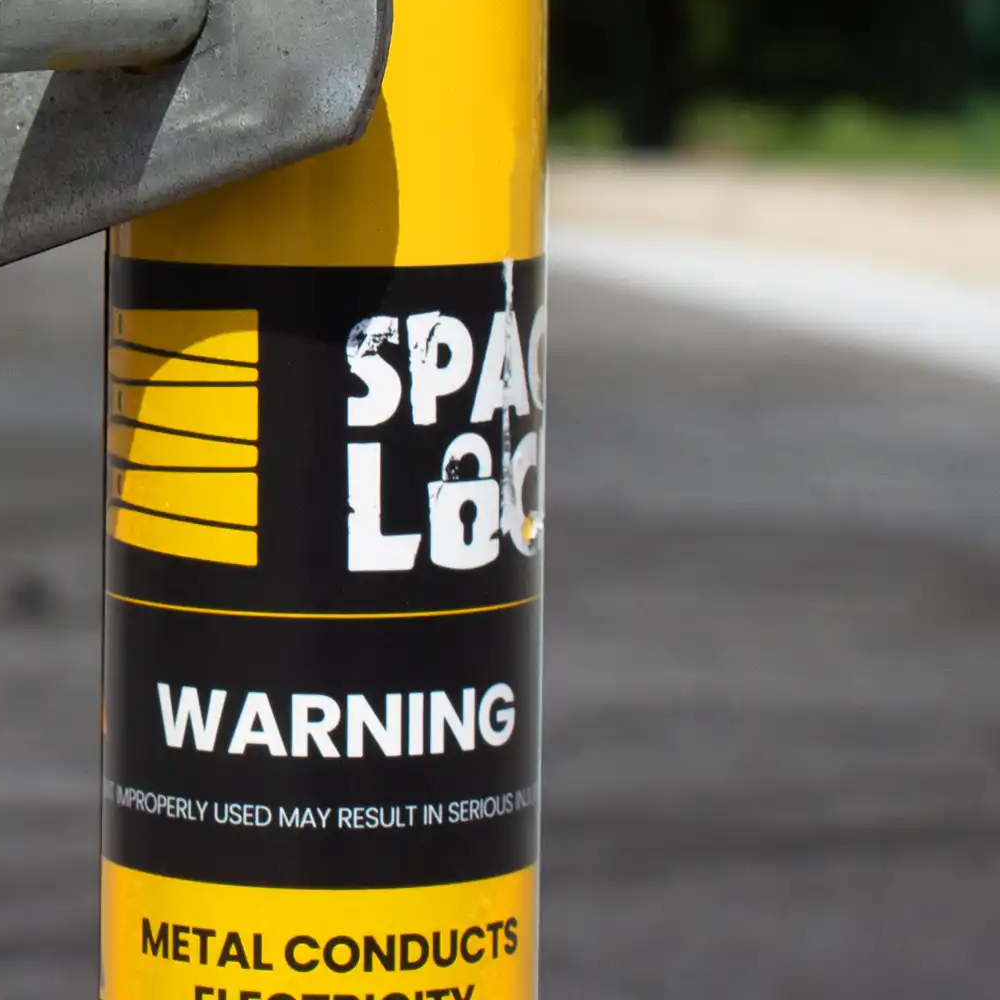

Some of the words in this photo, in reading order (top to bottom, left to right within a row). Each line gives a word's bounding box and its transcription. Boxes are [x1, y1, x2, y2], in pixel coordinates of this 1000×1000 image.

[157, 681, 516, 758] WARNING
[213, 801, 272, 827] USED
[279, 807, 331, 828] MAY
[338, 805, 417, 829] RESULT
[423, 803, 443, 825] IN
[448, 792, 514, 823] SERIOUS
[142, 917, 273, 971] METAL
[284, 916, 518, 973] CONDUCTS
